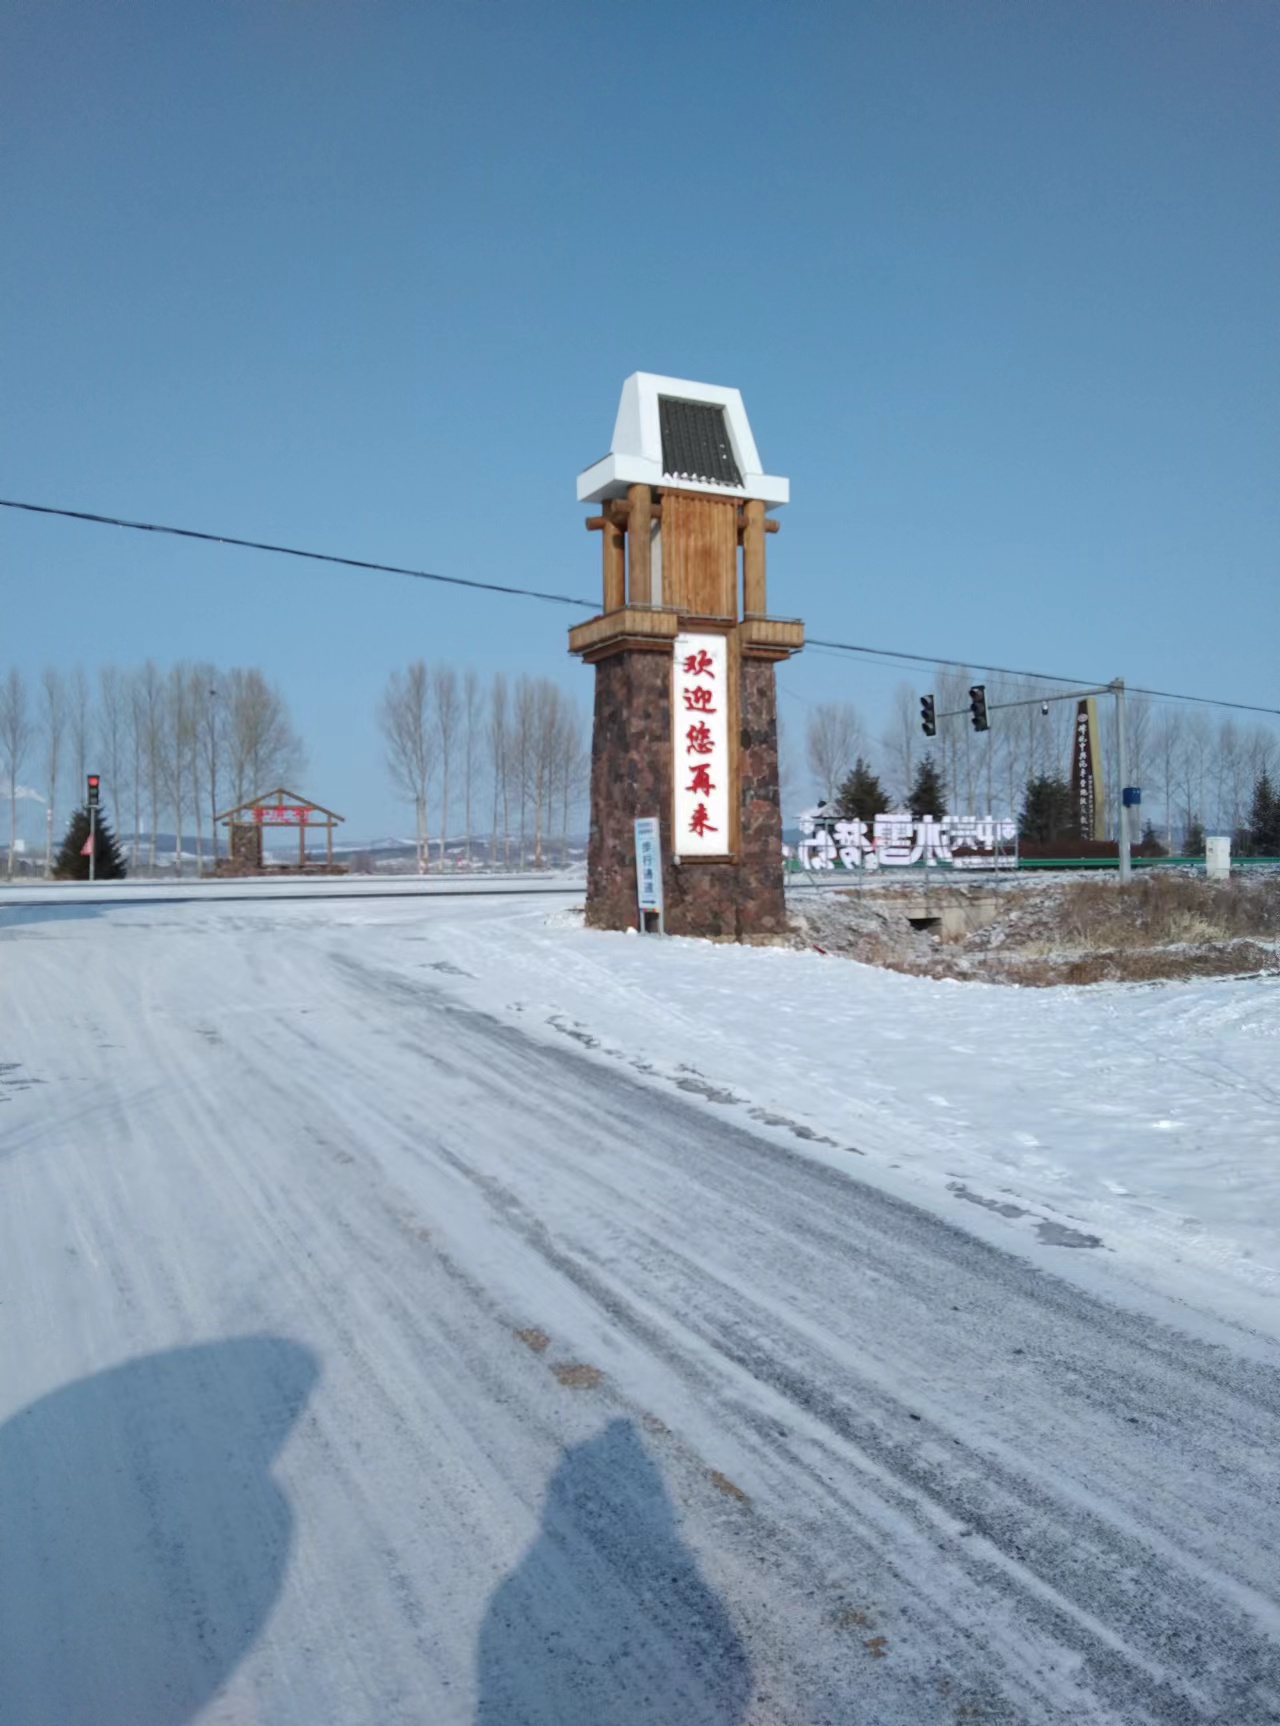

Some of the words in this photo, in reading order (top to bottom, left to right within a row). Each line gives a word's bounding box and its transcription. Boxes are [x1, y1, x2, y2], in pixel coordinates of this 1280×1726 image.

[683, 649, 718, 838] 欢迎您再来
